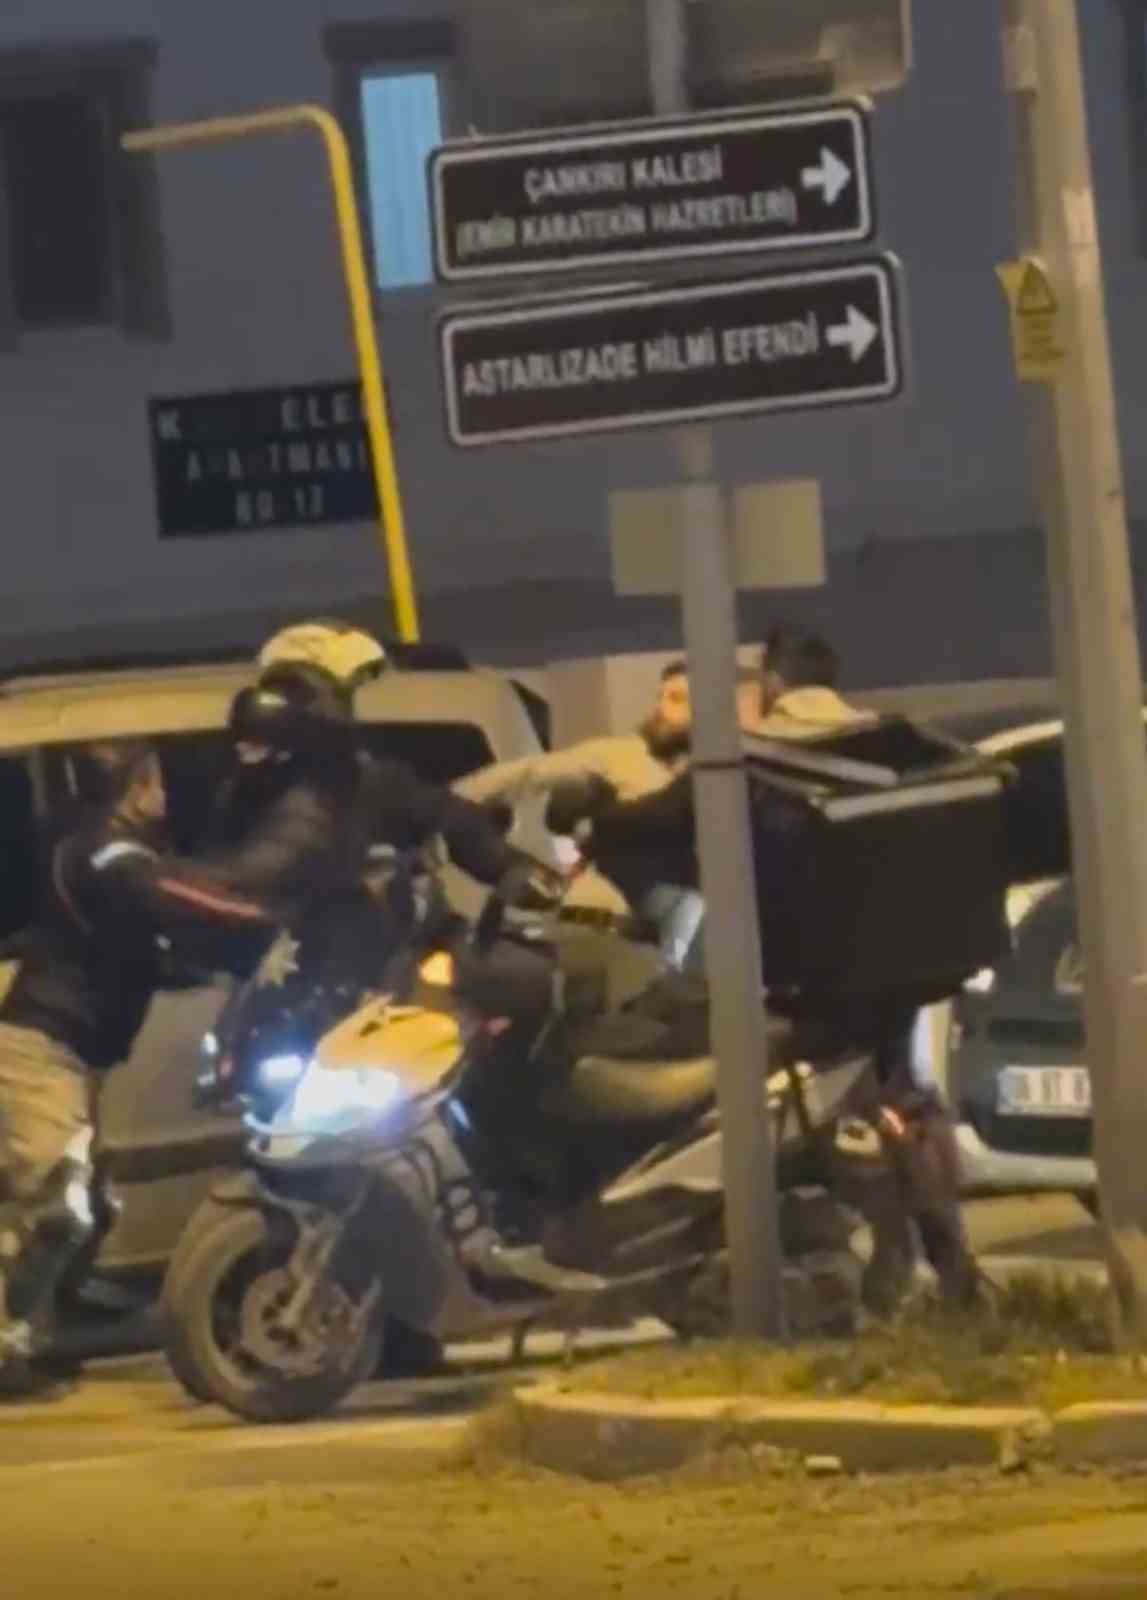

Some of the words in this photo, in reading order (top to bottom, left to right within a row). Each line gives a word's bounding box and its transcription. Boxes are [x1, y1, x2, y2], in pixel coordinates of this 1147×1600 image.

[523, 162, 627, 204] ÇANKIRI
[632, 144, 723, 188] KALESİ
[463, 342, 638, 397] ASTARLIZADE
[643, 327, 716, 373] HİLMİ
[722, 310, 819, 365] EFENDİ
